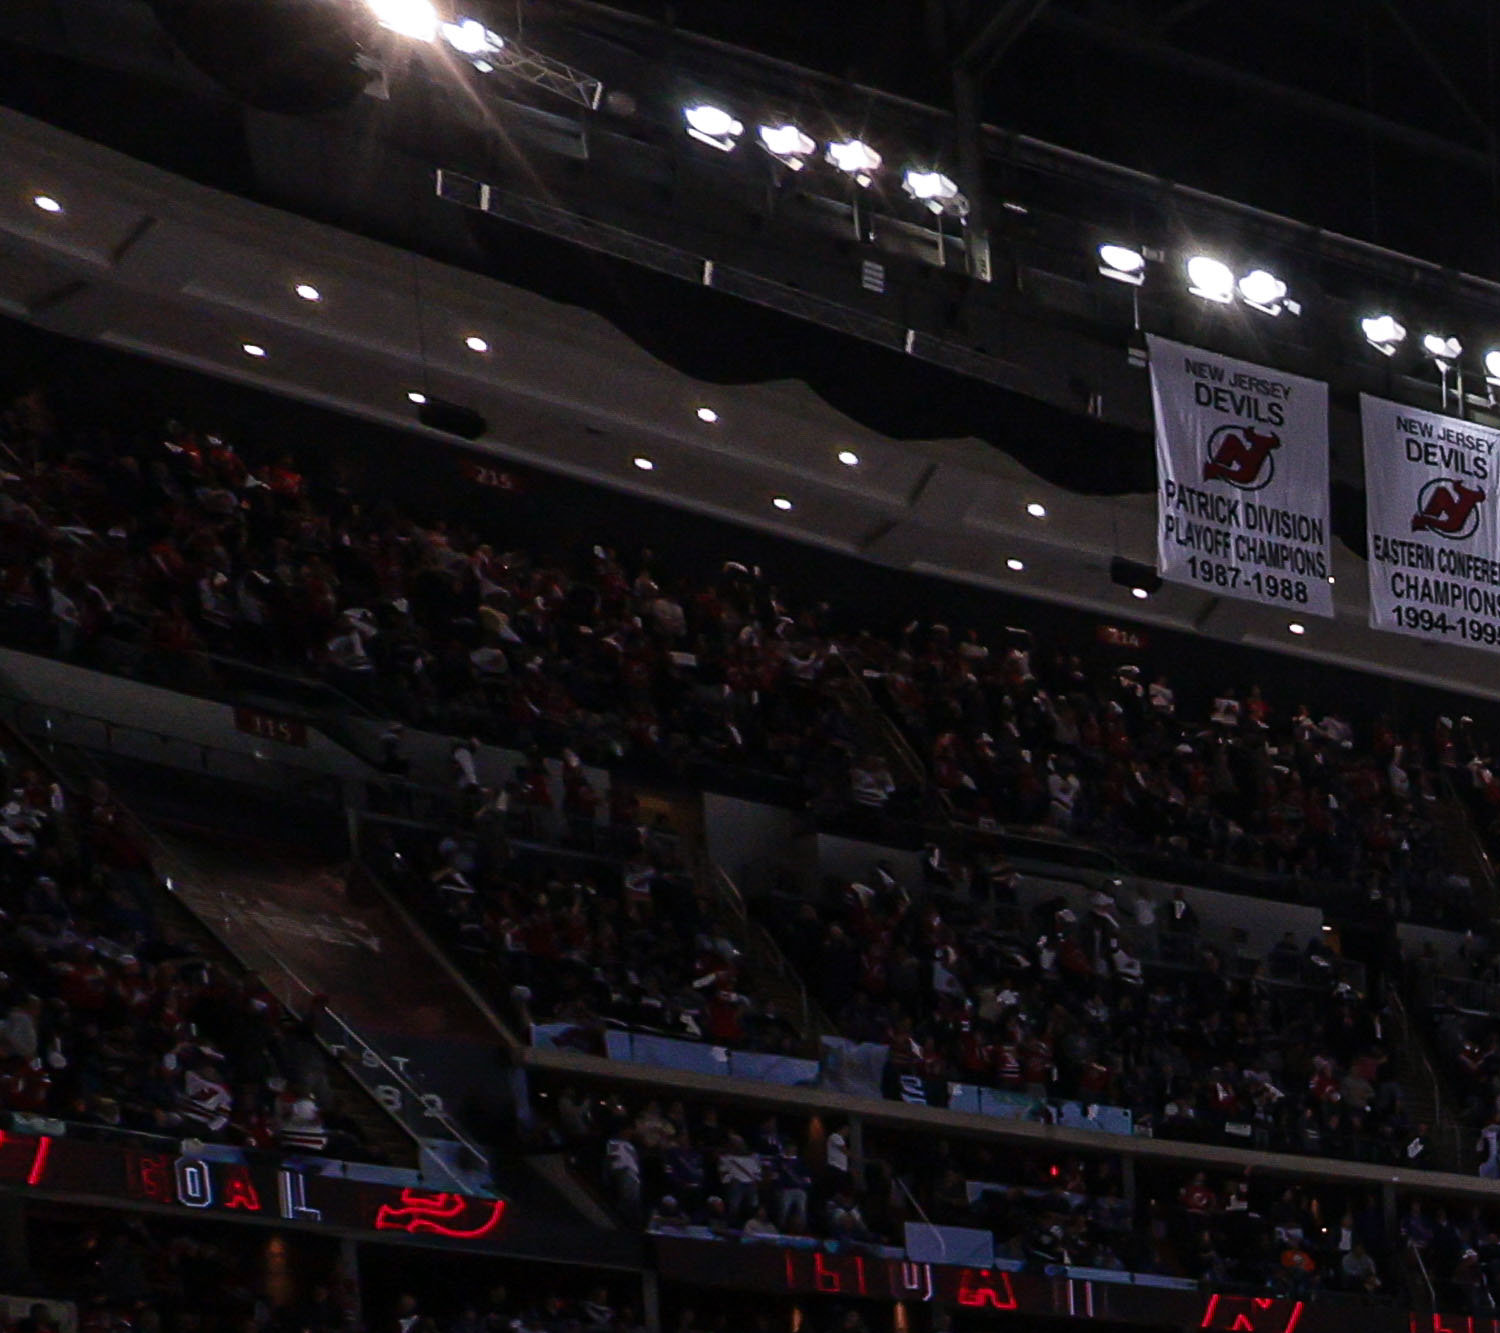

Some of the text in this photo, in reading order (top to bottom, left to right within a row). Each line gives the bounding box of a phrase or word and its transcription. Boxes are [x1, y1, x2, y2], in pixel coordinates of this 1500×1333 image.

[1195, 383, 1284, 426] DEVILS
[1406, 439, 1488, 479] DEVILS
[1166, 480, 1323, 545] PATRICK DIVISION
[1165, 515, 1326, 579] PLAYOFF CHAMPIONS
[1374, 535, 1434, 569] EASTERN
[1188, 555, 1308, 603] 1987-1988
